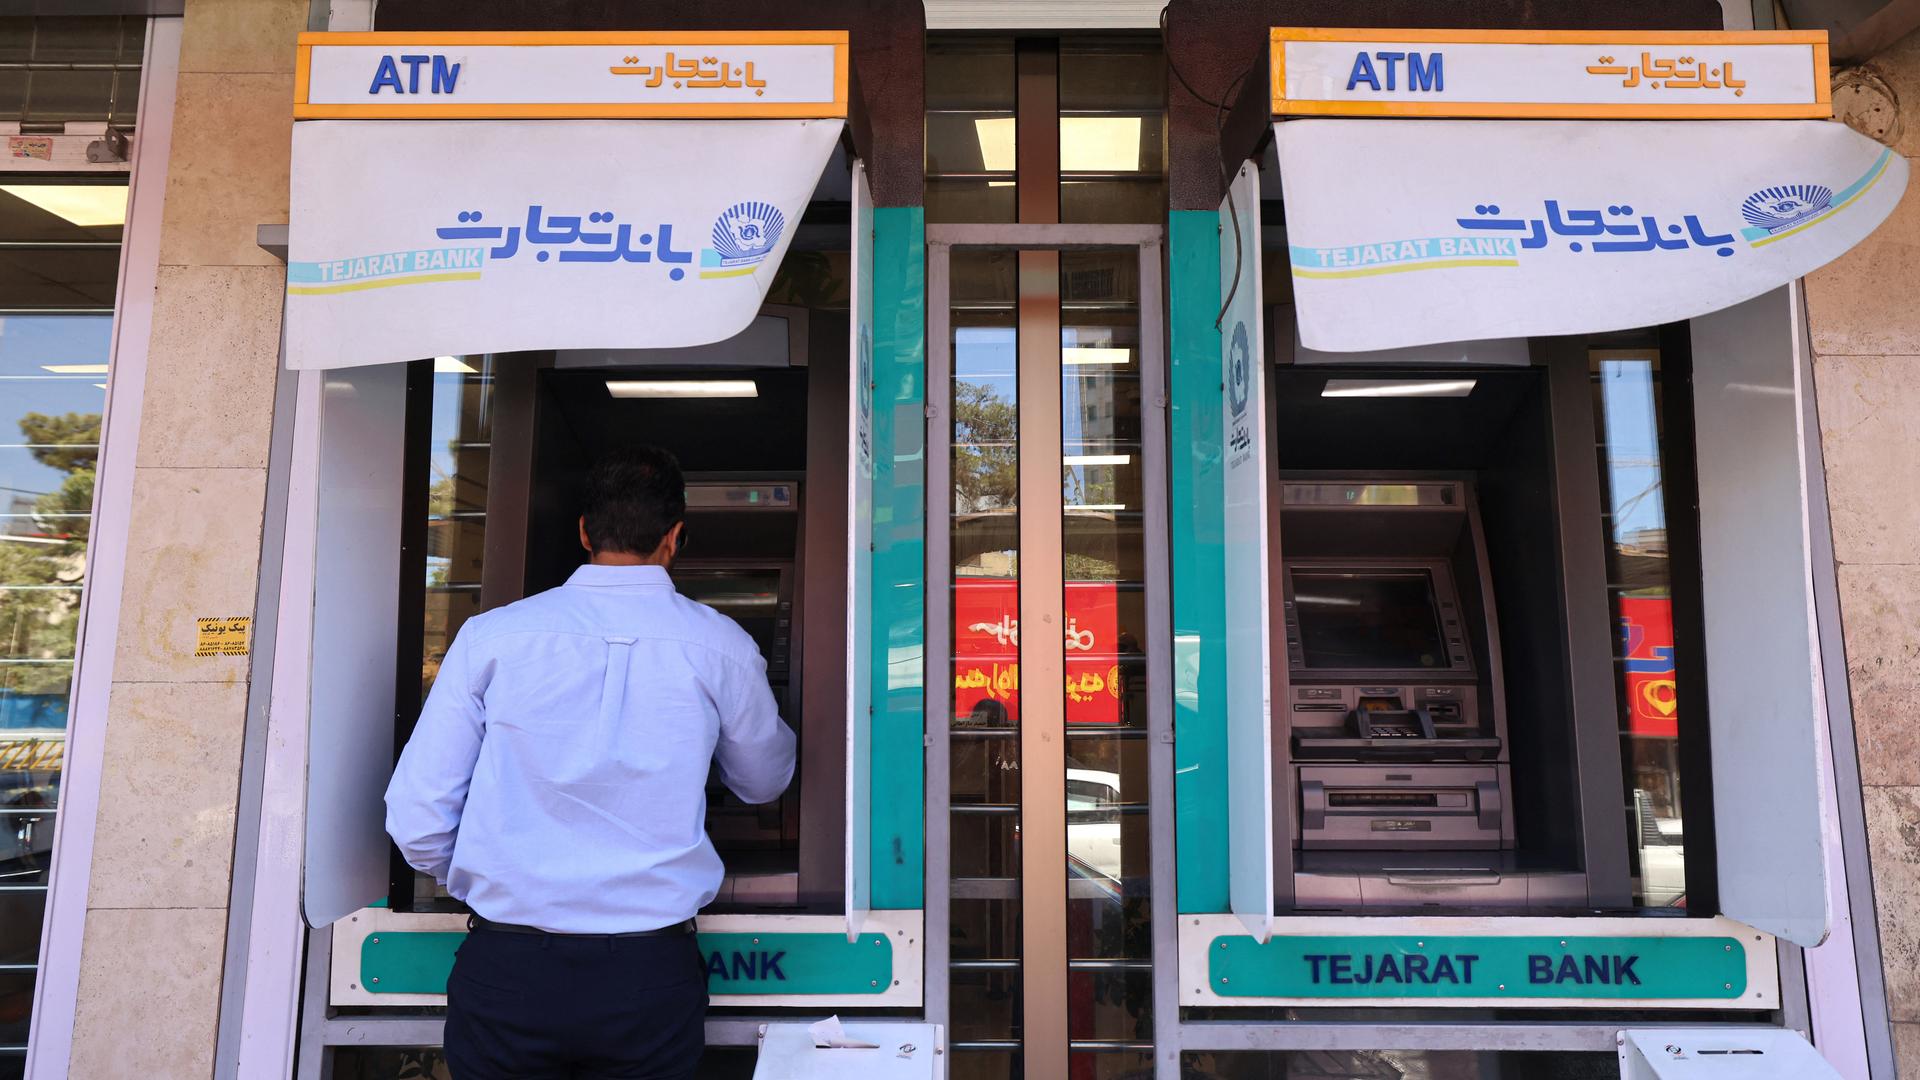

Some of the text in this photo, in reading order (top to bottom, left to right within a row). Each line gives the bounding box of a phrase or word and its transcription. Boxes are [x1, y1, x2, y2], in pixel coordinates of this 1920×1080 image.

[610, 52, 719, 89] تجارت
[1346, 51, 1444, 92] ATM
[1586, 52, 1697, 90] تجارت
[436, 205, 614, 262] تجارت
[1456, 200, 1641, 253] تجارت
[318, 249, 480, 282] TEJARAT BANK
[1315, 238, 1514, 267] TEJARAT BANK
[706, 950, 787, 981] ANK
[1303, 953, 1641, 986] TEJARAT BANK
